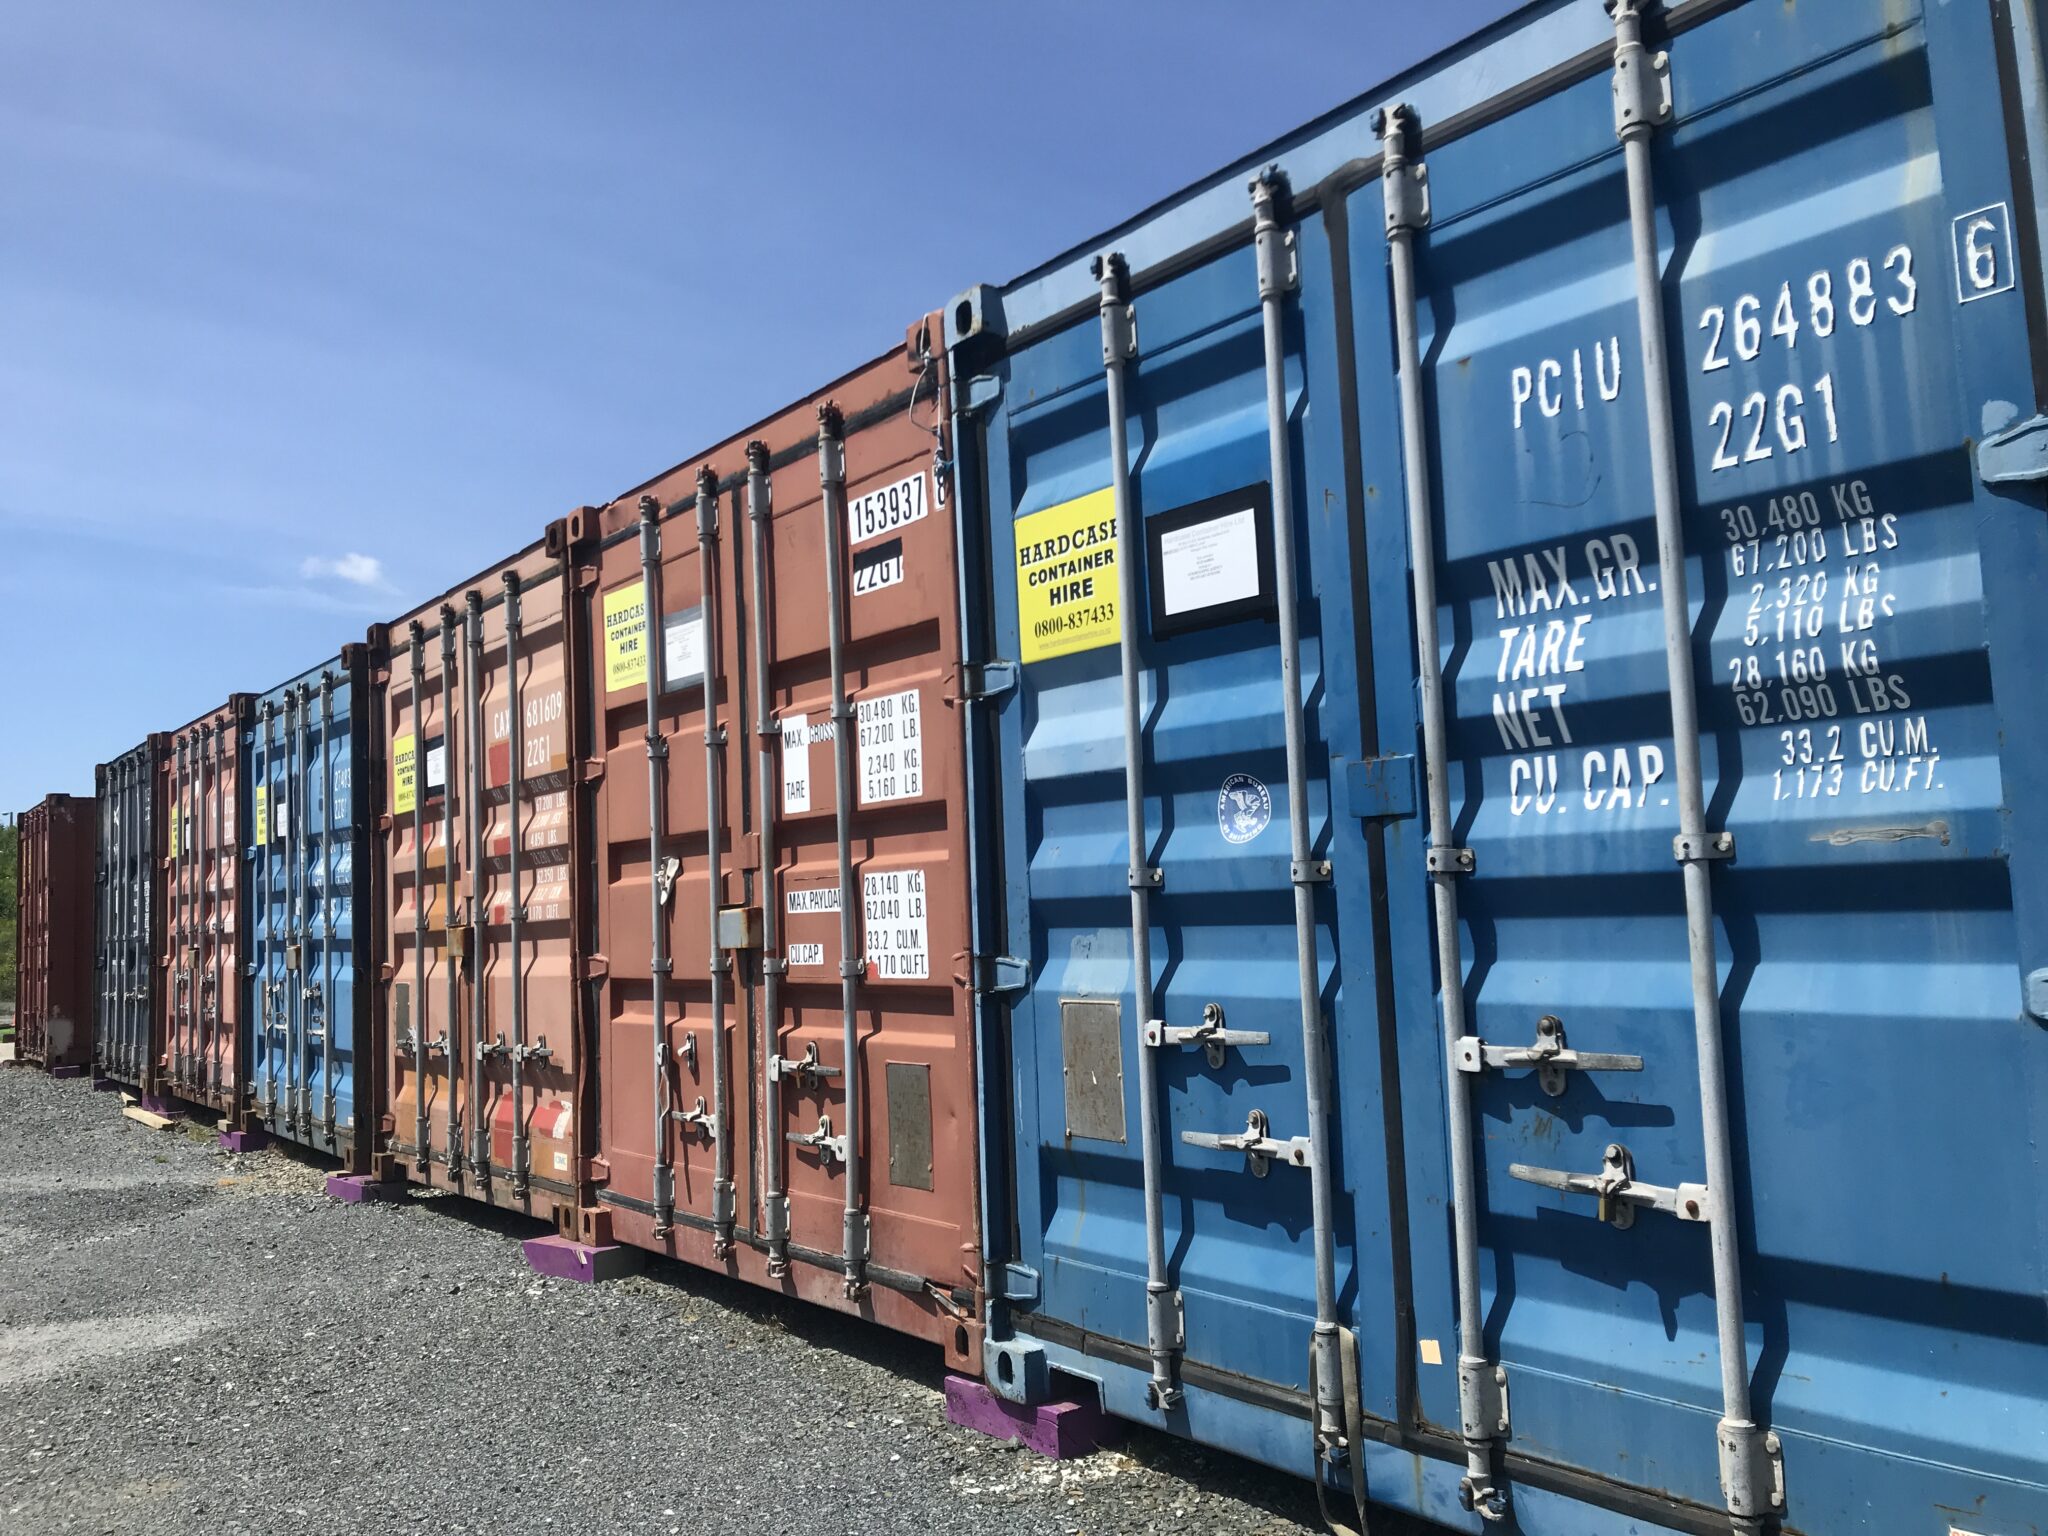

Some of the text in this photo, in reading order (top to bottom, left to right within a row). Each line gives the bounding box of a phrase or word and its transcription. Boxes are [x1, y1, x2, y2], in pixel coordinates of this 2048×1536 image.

[1511, 216, 1996, 429] PCIU 264883 6
[1708, 372, 1838, 473] 22G1
[854, 475, 923, 538] 153937
[1720, 480, 1875, 541] 30,480 KG
[1731, 513, 1898, 577] 67,200 LBS
[1029, 548, 1114, 587] CONTAINER
[1049, 577, 1094, 607] HIRE
[1748, 562, 1881, 614] 2,320 KG
[606, 603, 645, 628] HARDCAS
[1034, 603, 1114, 638] 0800-837433
[1744, 594, 1897, 647] 5,110 LBS
[620, 638, 638, 655] HIRE
[1497, 613, 1592, 683] TARE
[1728, 639, 1881, 693] 28,160 KG
[494, 690, 562, 739] CAX 681609
[859, 693, 918, 724] 30.480 KG.
[1492, 684, 1573, 750] NET
[1735, 674, 1911, 726] 62,090 LBS
[527, 734, 550, 768] 22G1
[808, 722, 835, 744] GROSS
[860, 718, 919, 747] 67.200 LB.
[1780, 716, 1938, 766] 33.2 CU.M.
[868, 748, 920, 776] 2.340 KG.
[1582, 745, 1669, 811] CAP.
[786, 780, 806, 800] TARE
[868, 772, 921, 799] 5.160 LB.
[1220, 776, 1269, 810] AMERICAN BUREAU
[865, 872, 924, 896] 28.140 KG.
[866, 897, 925, 920] 62.040 LB.
[867, 930, 889, 950] 33.2
